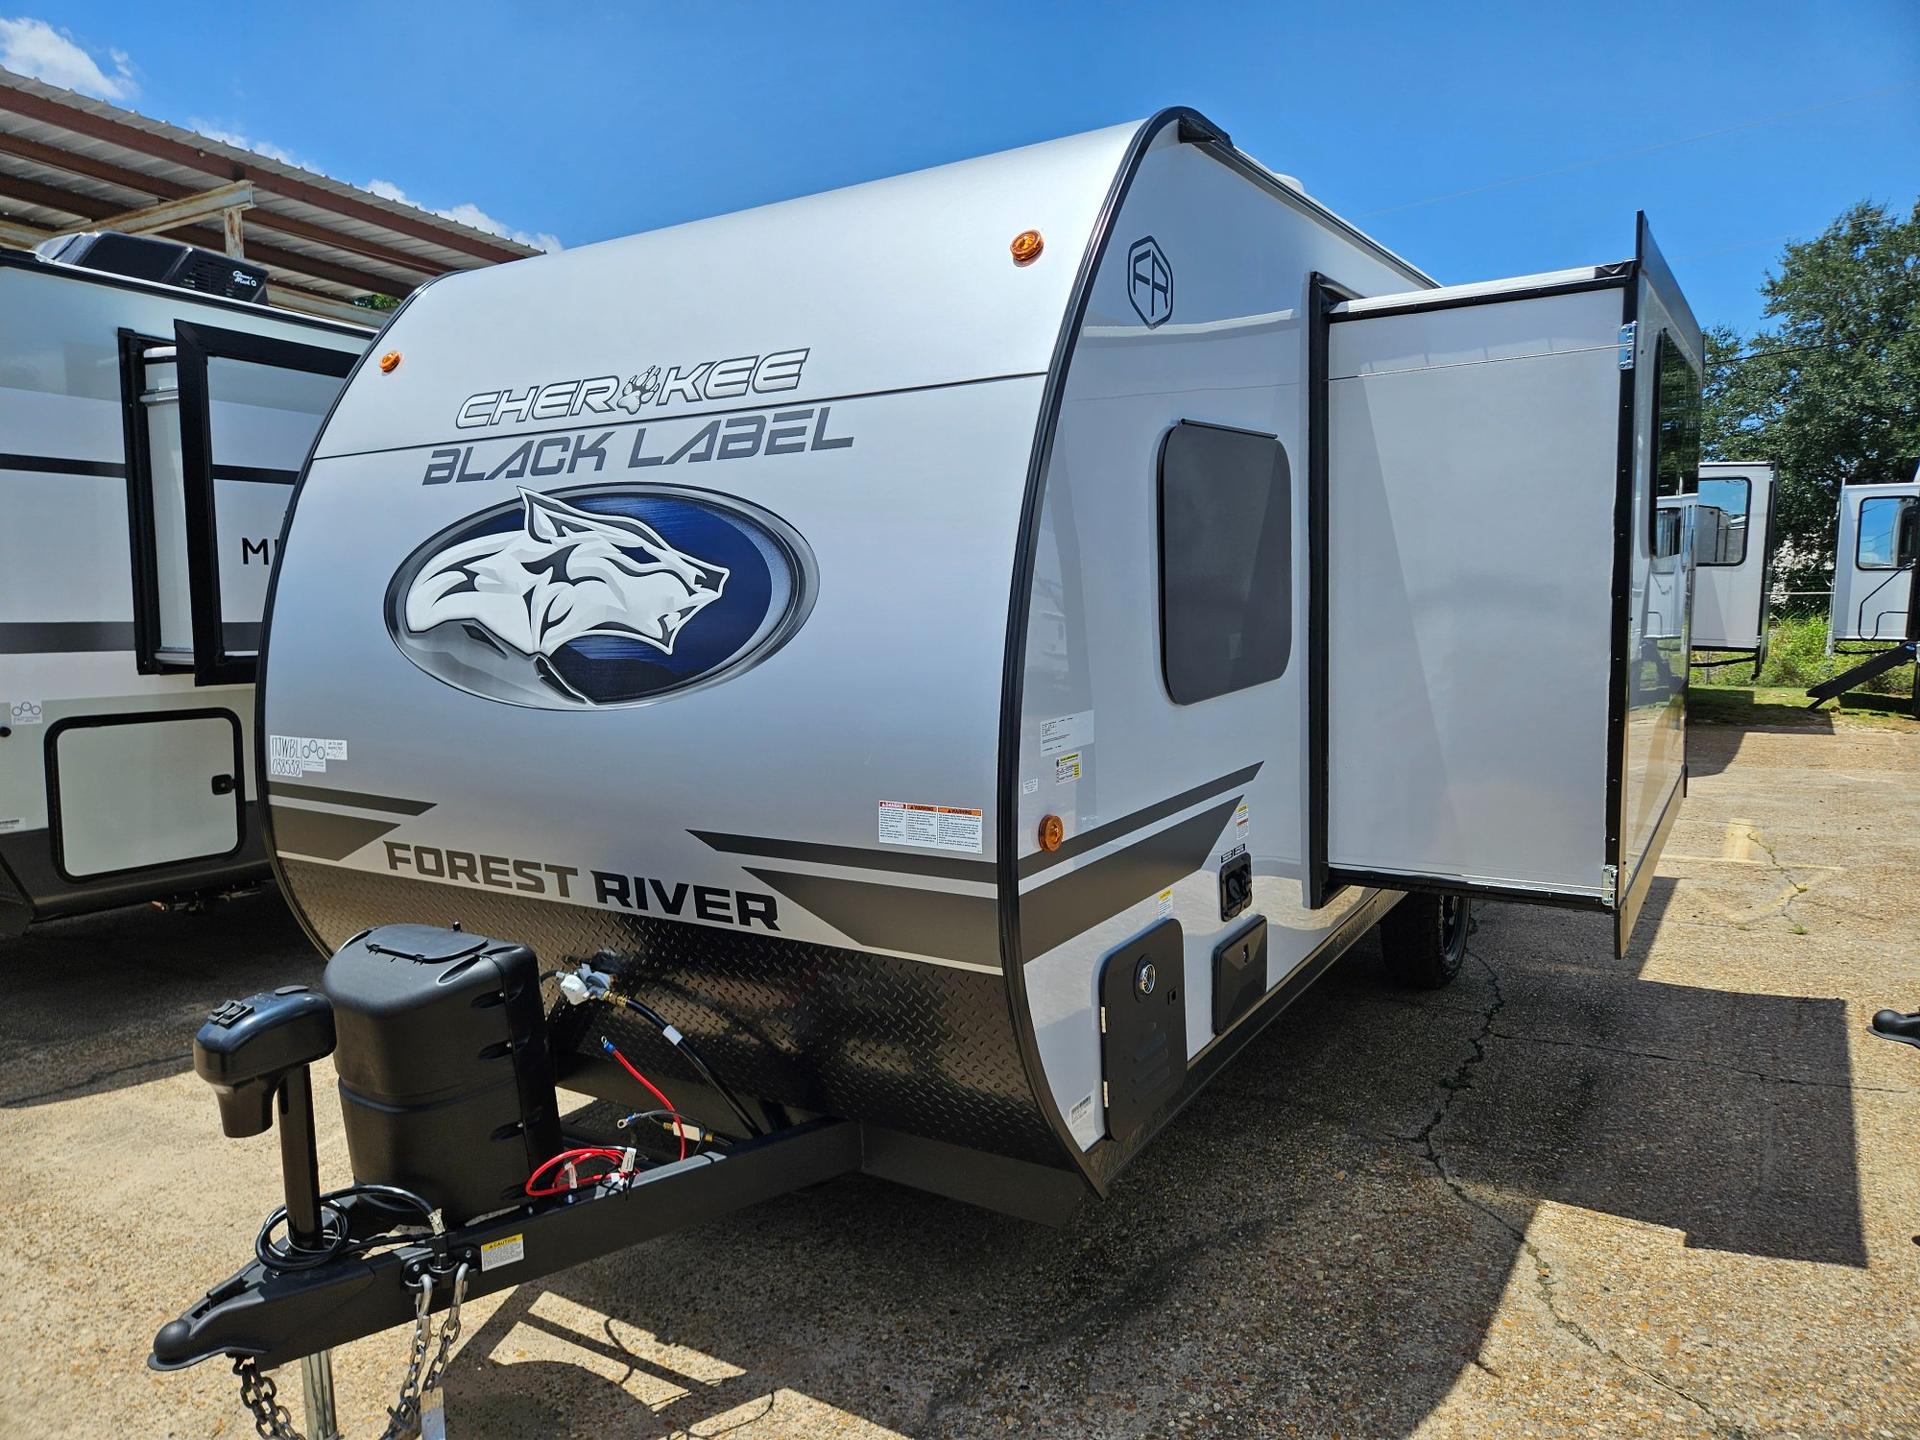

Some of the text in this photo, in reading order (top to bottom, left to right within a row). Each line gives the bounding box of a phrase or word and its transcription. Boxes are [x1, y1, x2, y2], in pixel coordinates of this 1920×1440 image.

[422, 406, 855, 486] BLACK LABEL
[242, 537, 279, 566] M
[383, 841, 781, 932] FOREST RIVER
